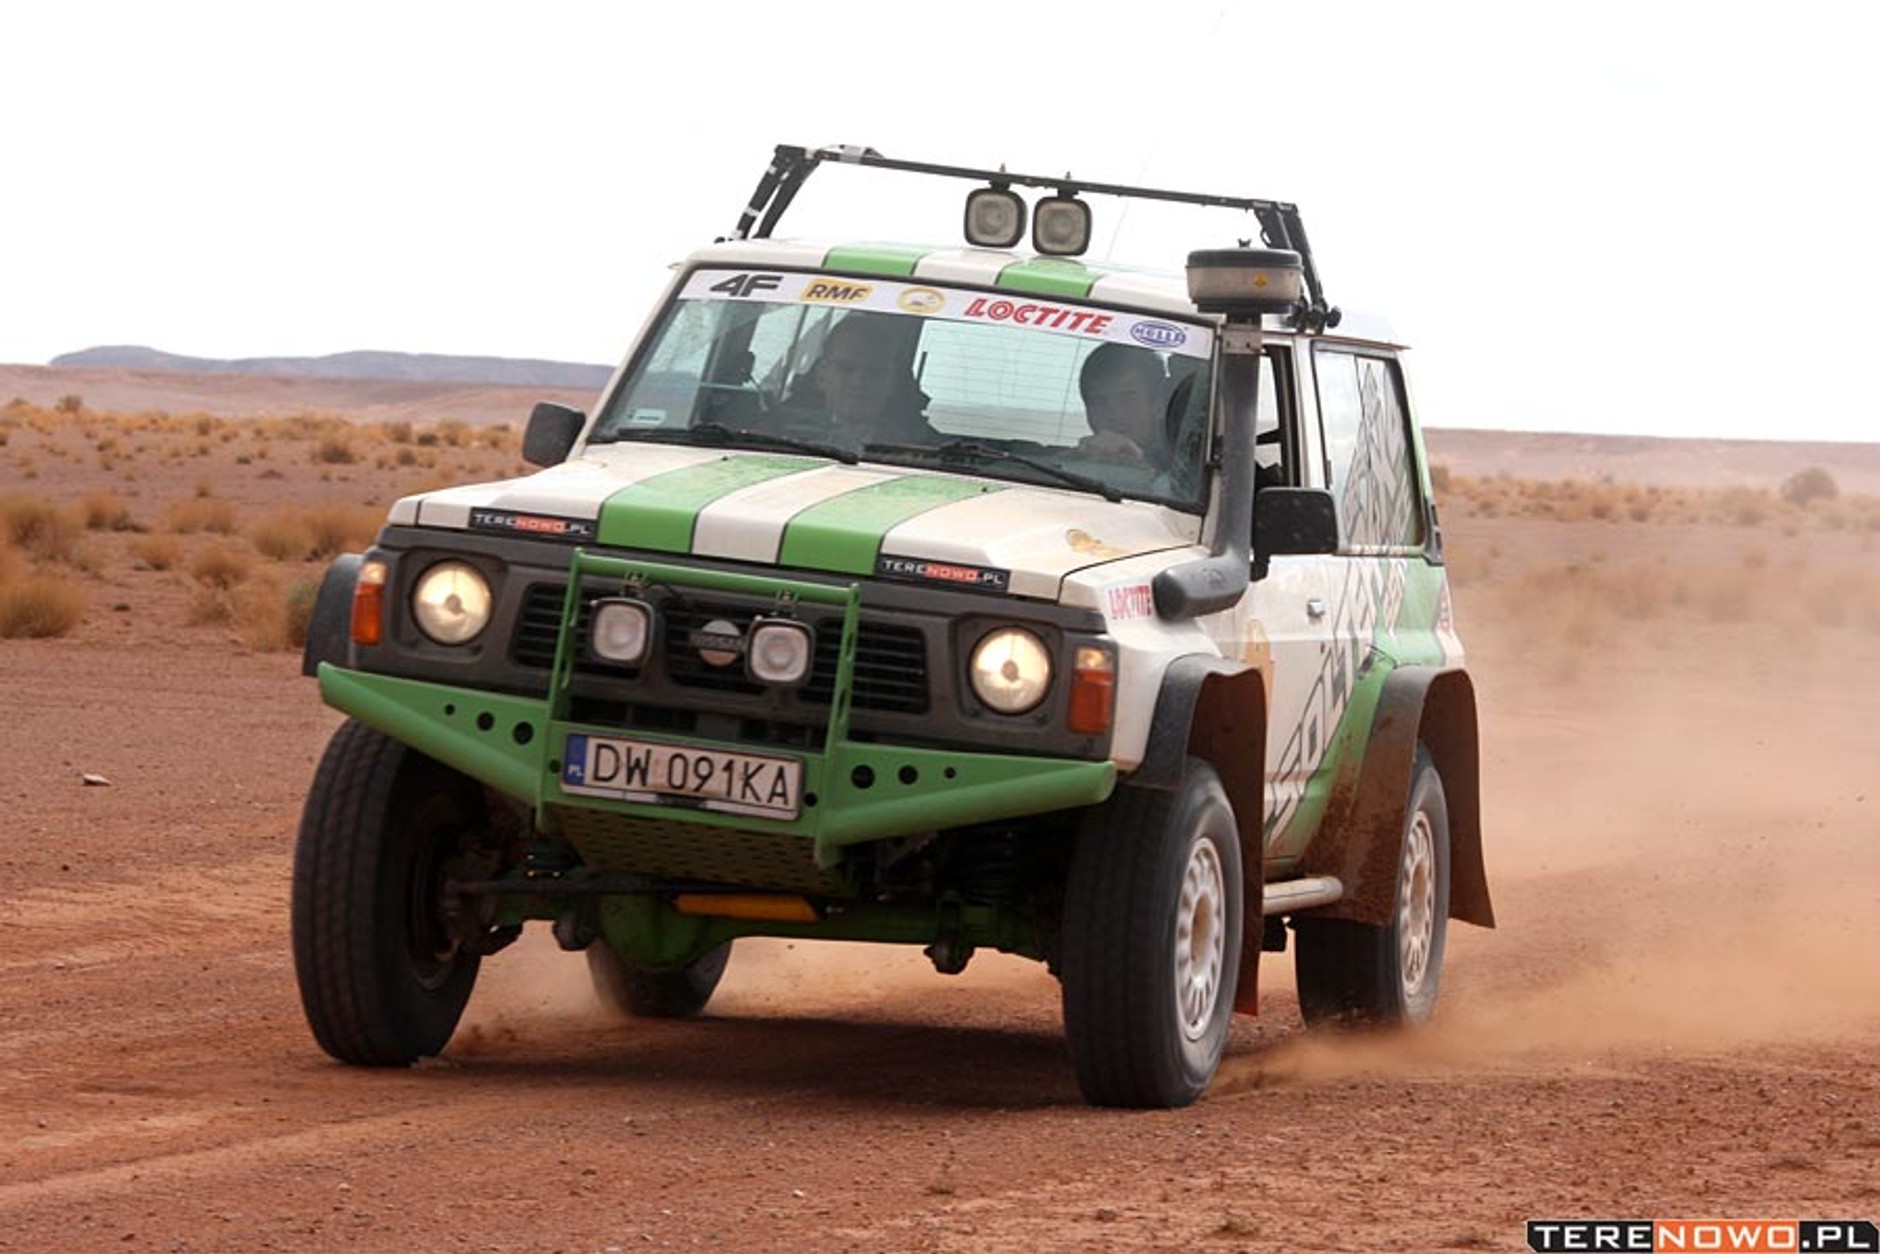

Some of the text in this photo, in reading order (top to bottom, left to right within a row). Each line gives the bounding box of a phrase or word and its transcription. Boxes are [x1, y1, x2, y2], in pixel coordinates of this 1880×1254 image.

[710, 274, 783, 297] 4F
[807, 284, 868, 300] RMF
[964, 299, 1113, 333] LOCTITE
[884, 560, 1003, 584] TERENOWO.PL
[593, 743, 789, 806] DW 091KA
